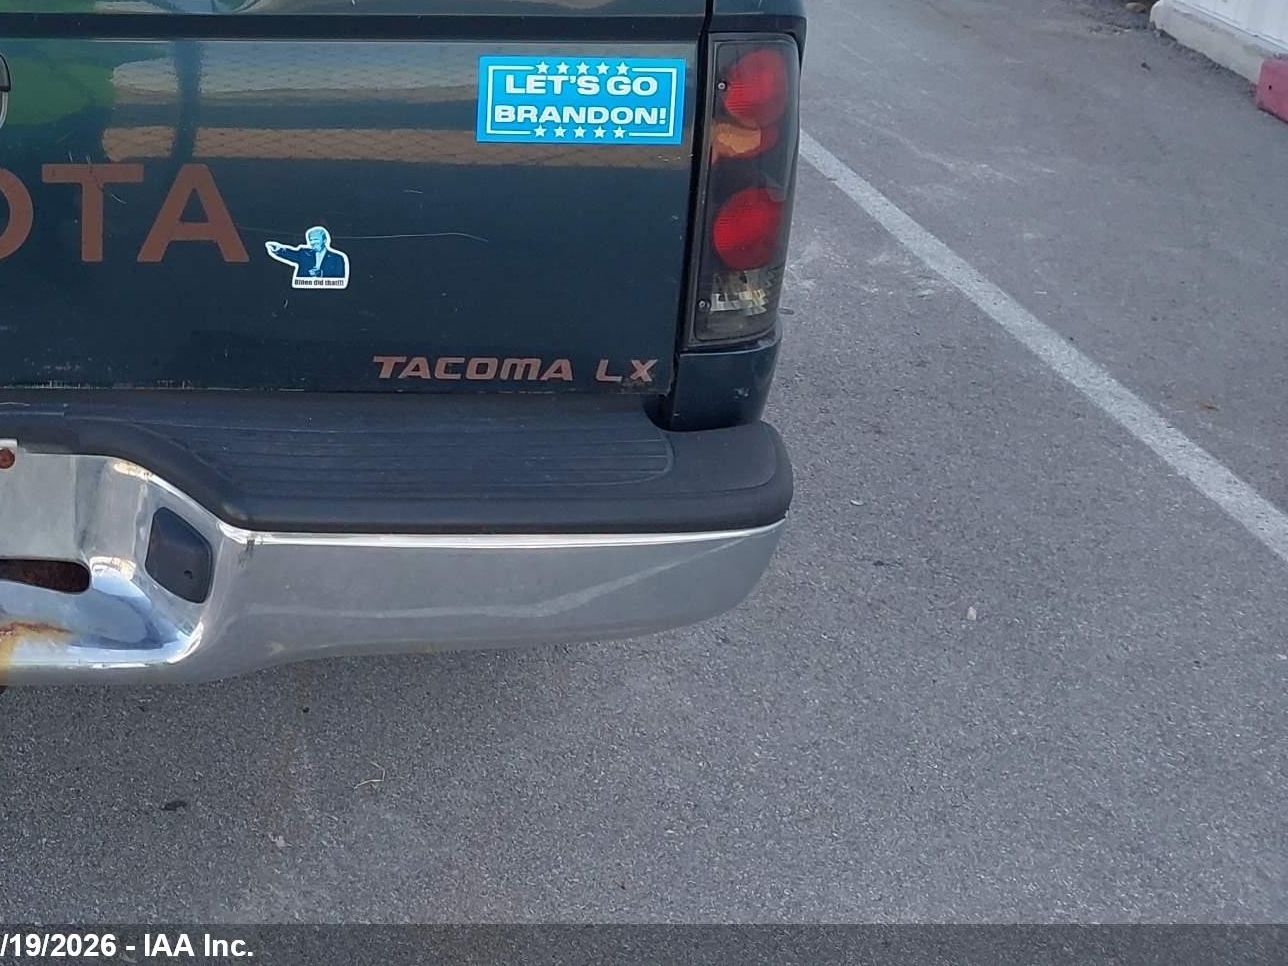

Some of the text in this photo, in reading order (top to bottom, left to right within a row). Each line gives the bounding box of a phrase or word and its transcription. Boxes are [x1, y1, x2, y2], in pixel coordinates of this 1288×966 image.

[505, 74, 658, 96] LET'S GO
[494, 105, 667, 125] BRANDON!
[313, 278, 324, 286] did
[373, 356, 658, 382] TACOMA LX
